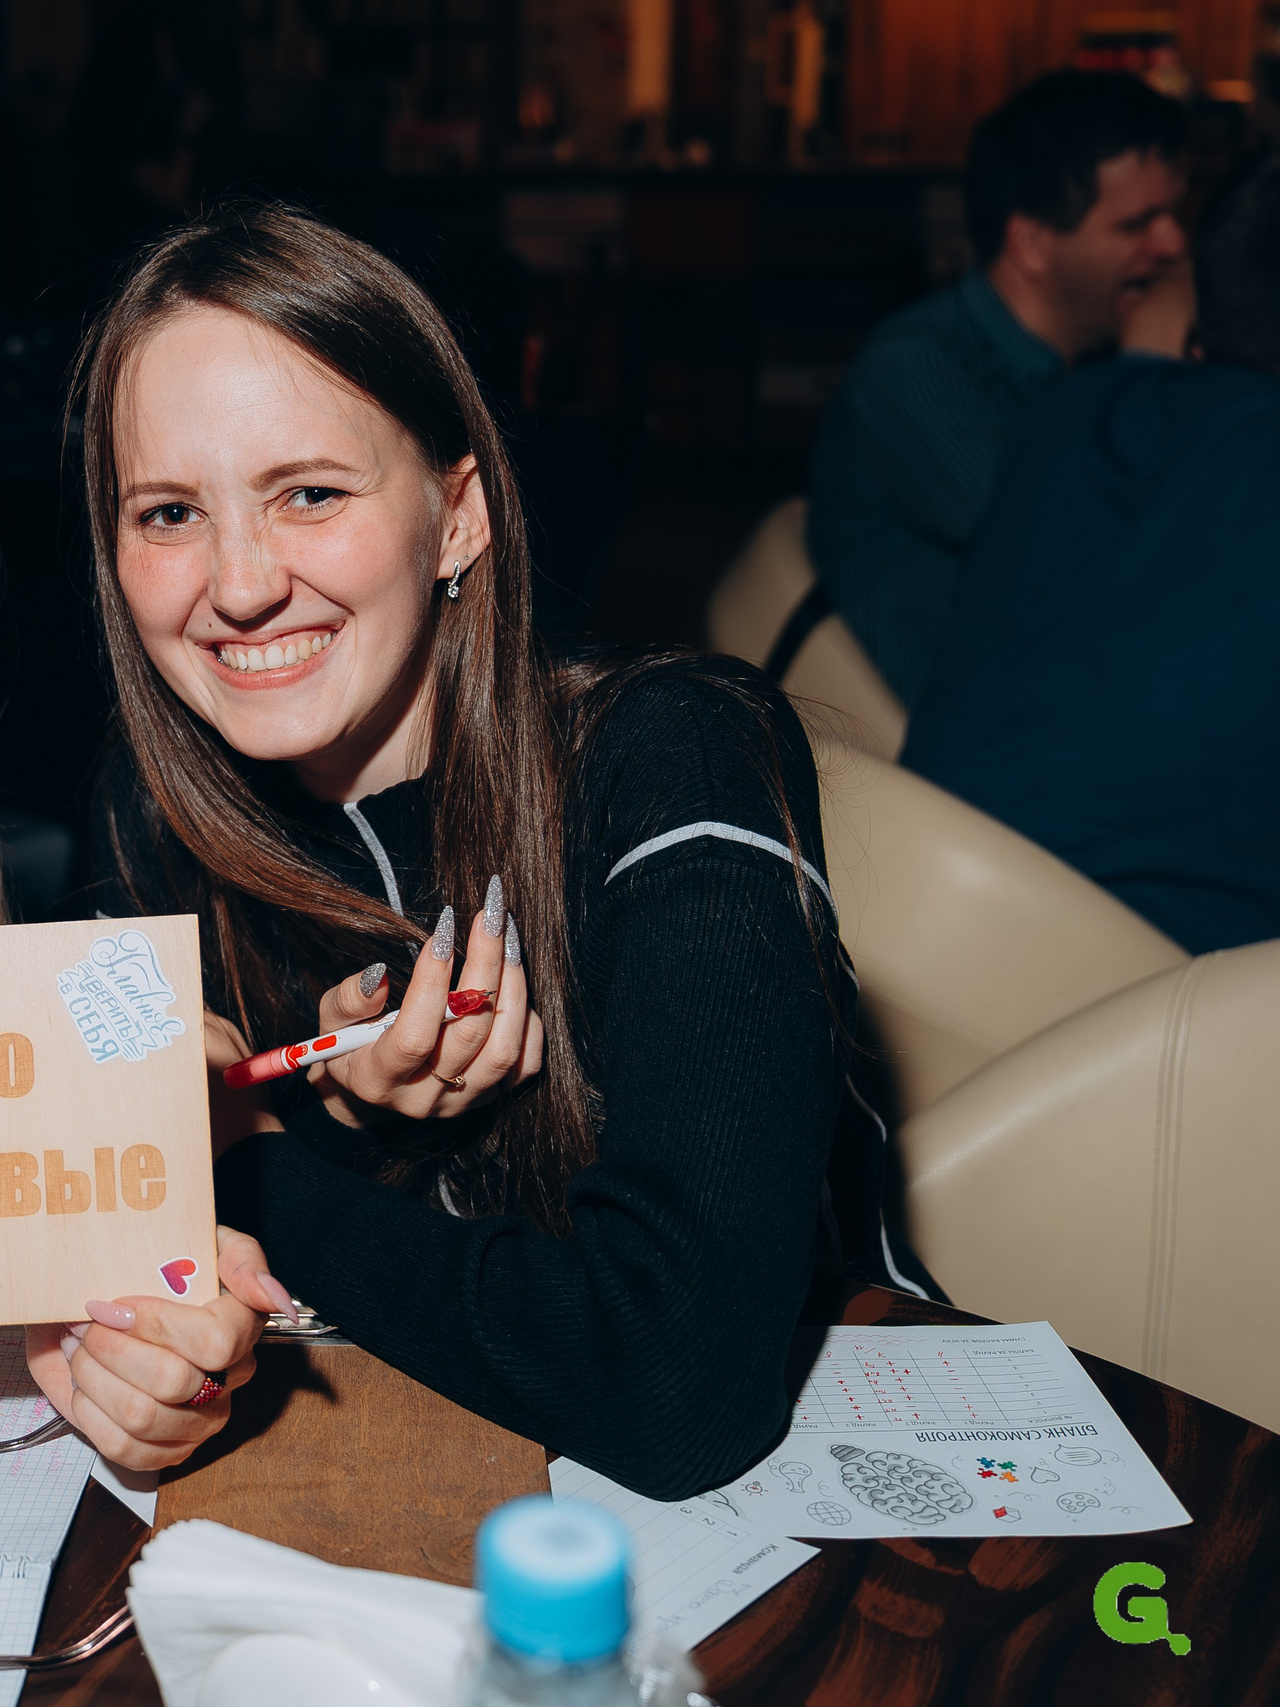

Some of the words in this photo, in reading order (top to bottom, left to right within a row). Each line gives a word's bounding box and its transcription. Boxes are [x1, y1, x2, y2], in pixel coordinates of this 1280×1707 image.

[85, 979, 132, 1038] ВЕРИТЬ
[69, 996, 120, 1062] СЕБЯ
[1027, 1415, 1063, 1424] ВОПРОСА
[914, 1429, 1042, 1442] САМОКОНТРОЛЯ
[1042, 1424, 1099, 1438] БЛАНК
[680, 1506, 692, 1515] 3
[702, 1517, 715, 1526] 2
[732, 1543, 780, 1575] Команда
